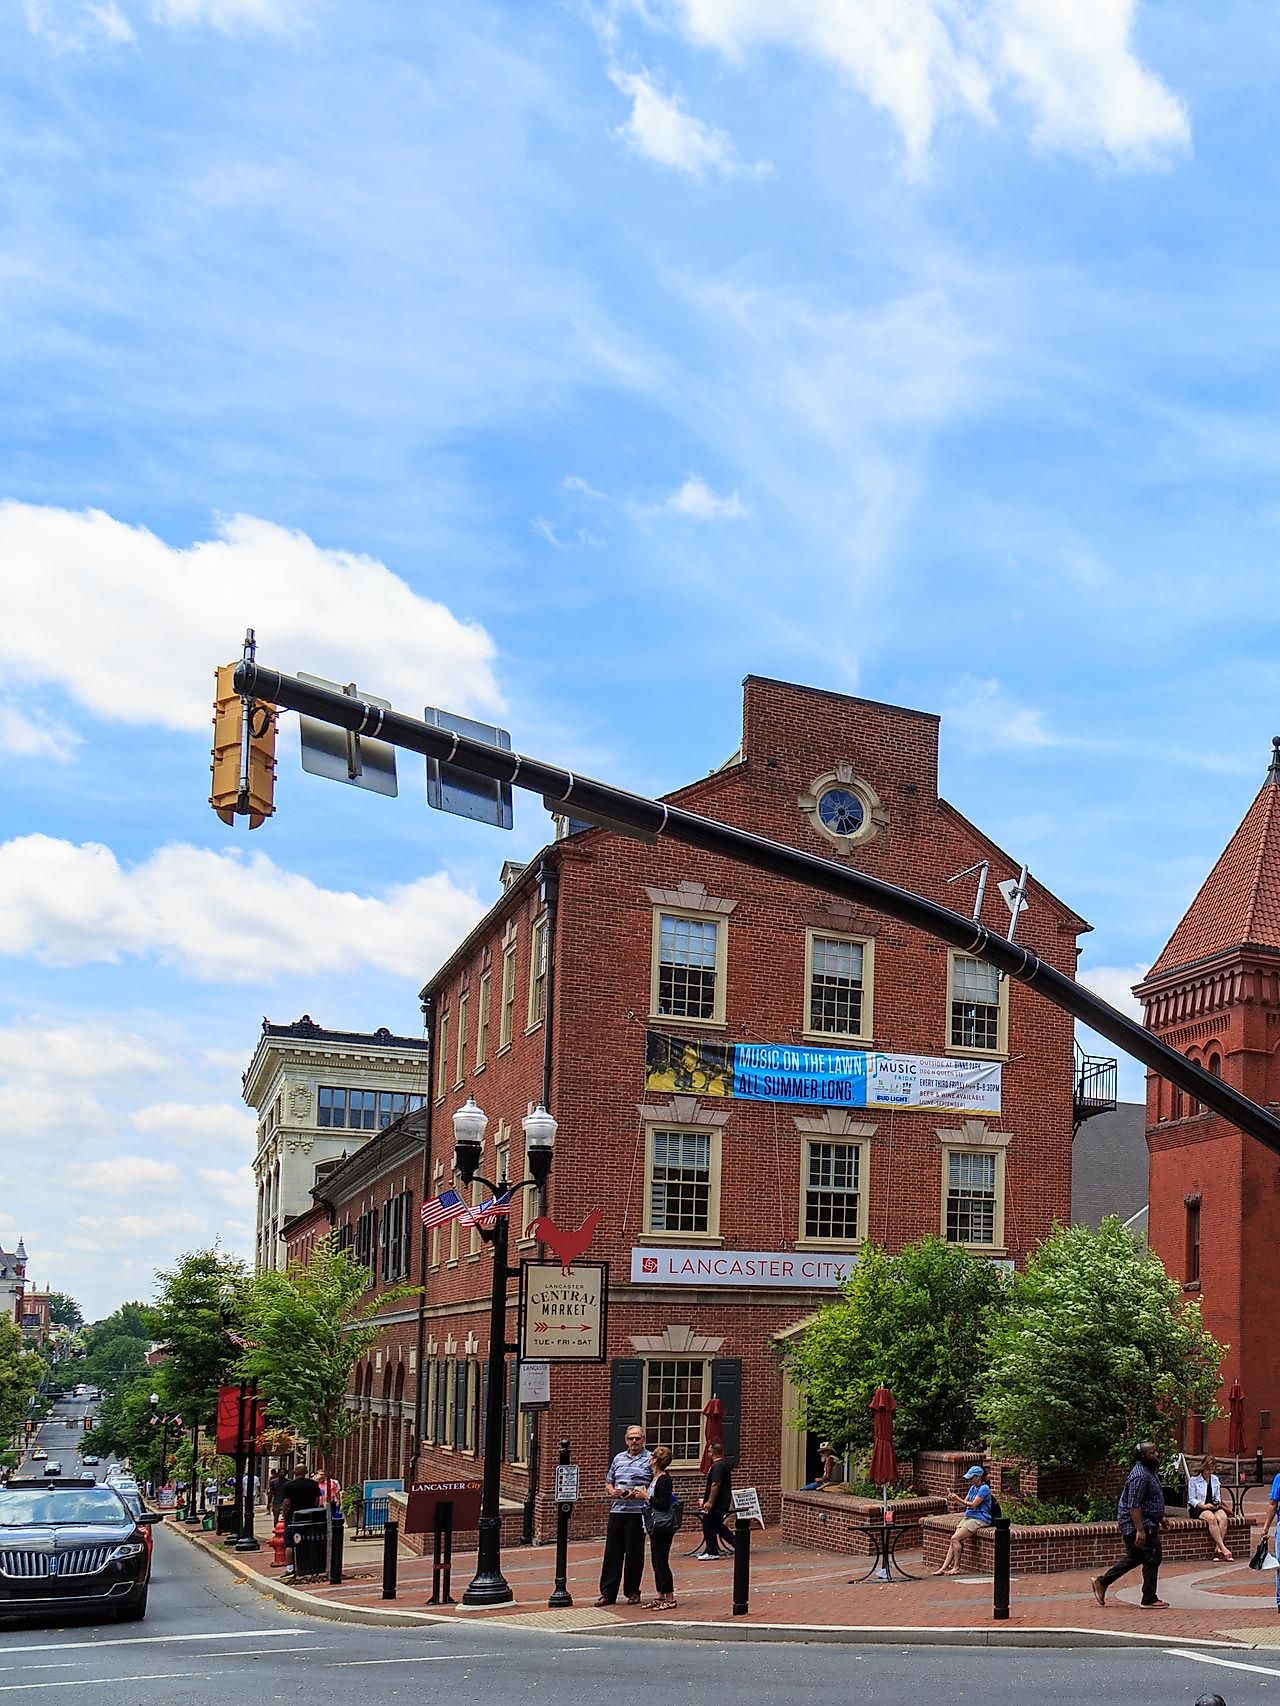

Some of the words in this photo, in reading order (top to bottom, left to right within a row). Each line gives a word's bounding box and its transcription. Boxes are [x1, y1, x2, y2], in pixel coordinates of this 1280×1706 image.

[739, 1047, 780, 1070] MUSIC
[783, 1051, 800, 1071] ON
[803, 1053, 825, 1073] THE
[828, 1055, 866, 1076] LAWN.
[879, 1062, 917, 1075] MUSIC
[738, 1073, 760, 1094] ALL
[763, 1075, 818, 1099] SUMMER
[821, 1079, 856, 1101] LONG.
[919, 1078, 933, 1087] EVERY
[935, 1080, 949, 1089] THIRD
[949, 1080, 965, 1090] FRIDAY
[956, 1093, 985, 1101] AVAILABLE
[668, 1257, 794, 1277] LANCASTER
[801, 1262, 845, 1278] CITY
[531, 1290, 597, 1307] CENTRAL
[542, 1303, 586, 1316] MARKET
[411, 1482, 465, 1492] LANCASTER
[466, 1481, 480, 1490] City
